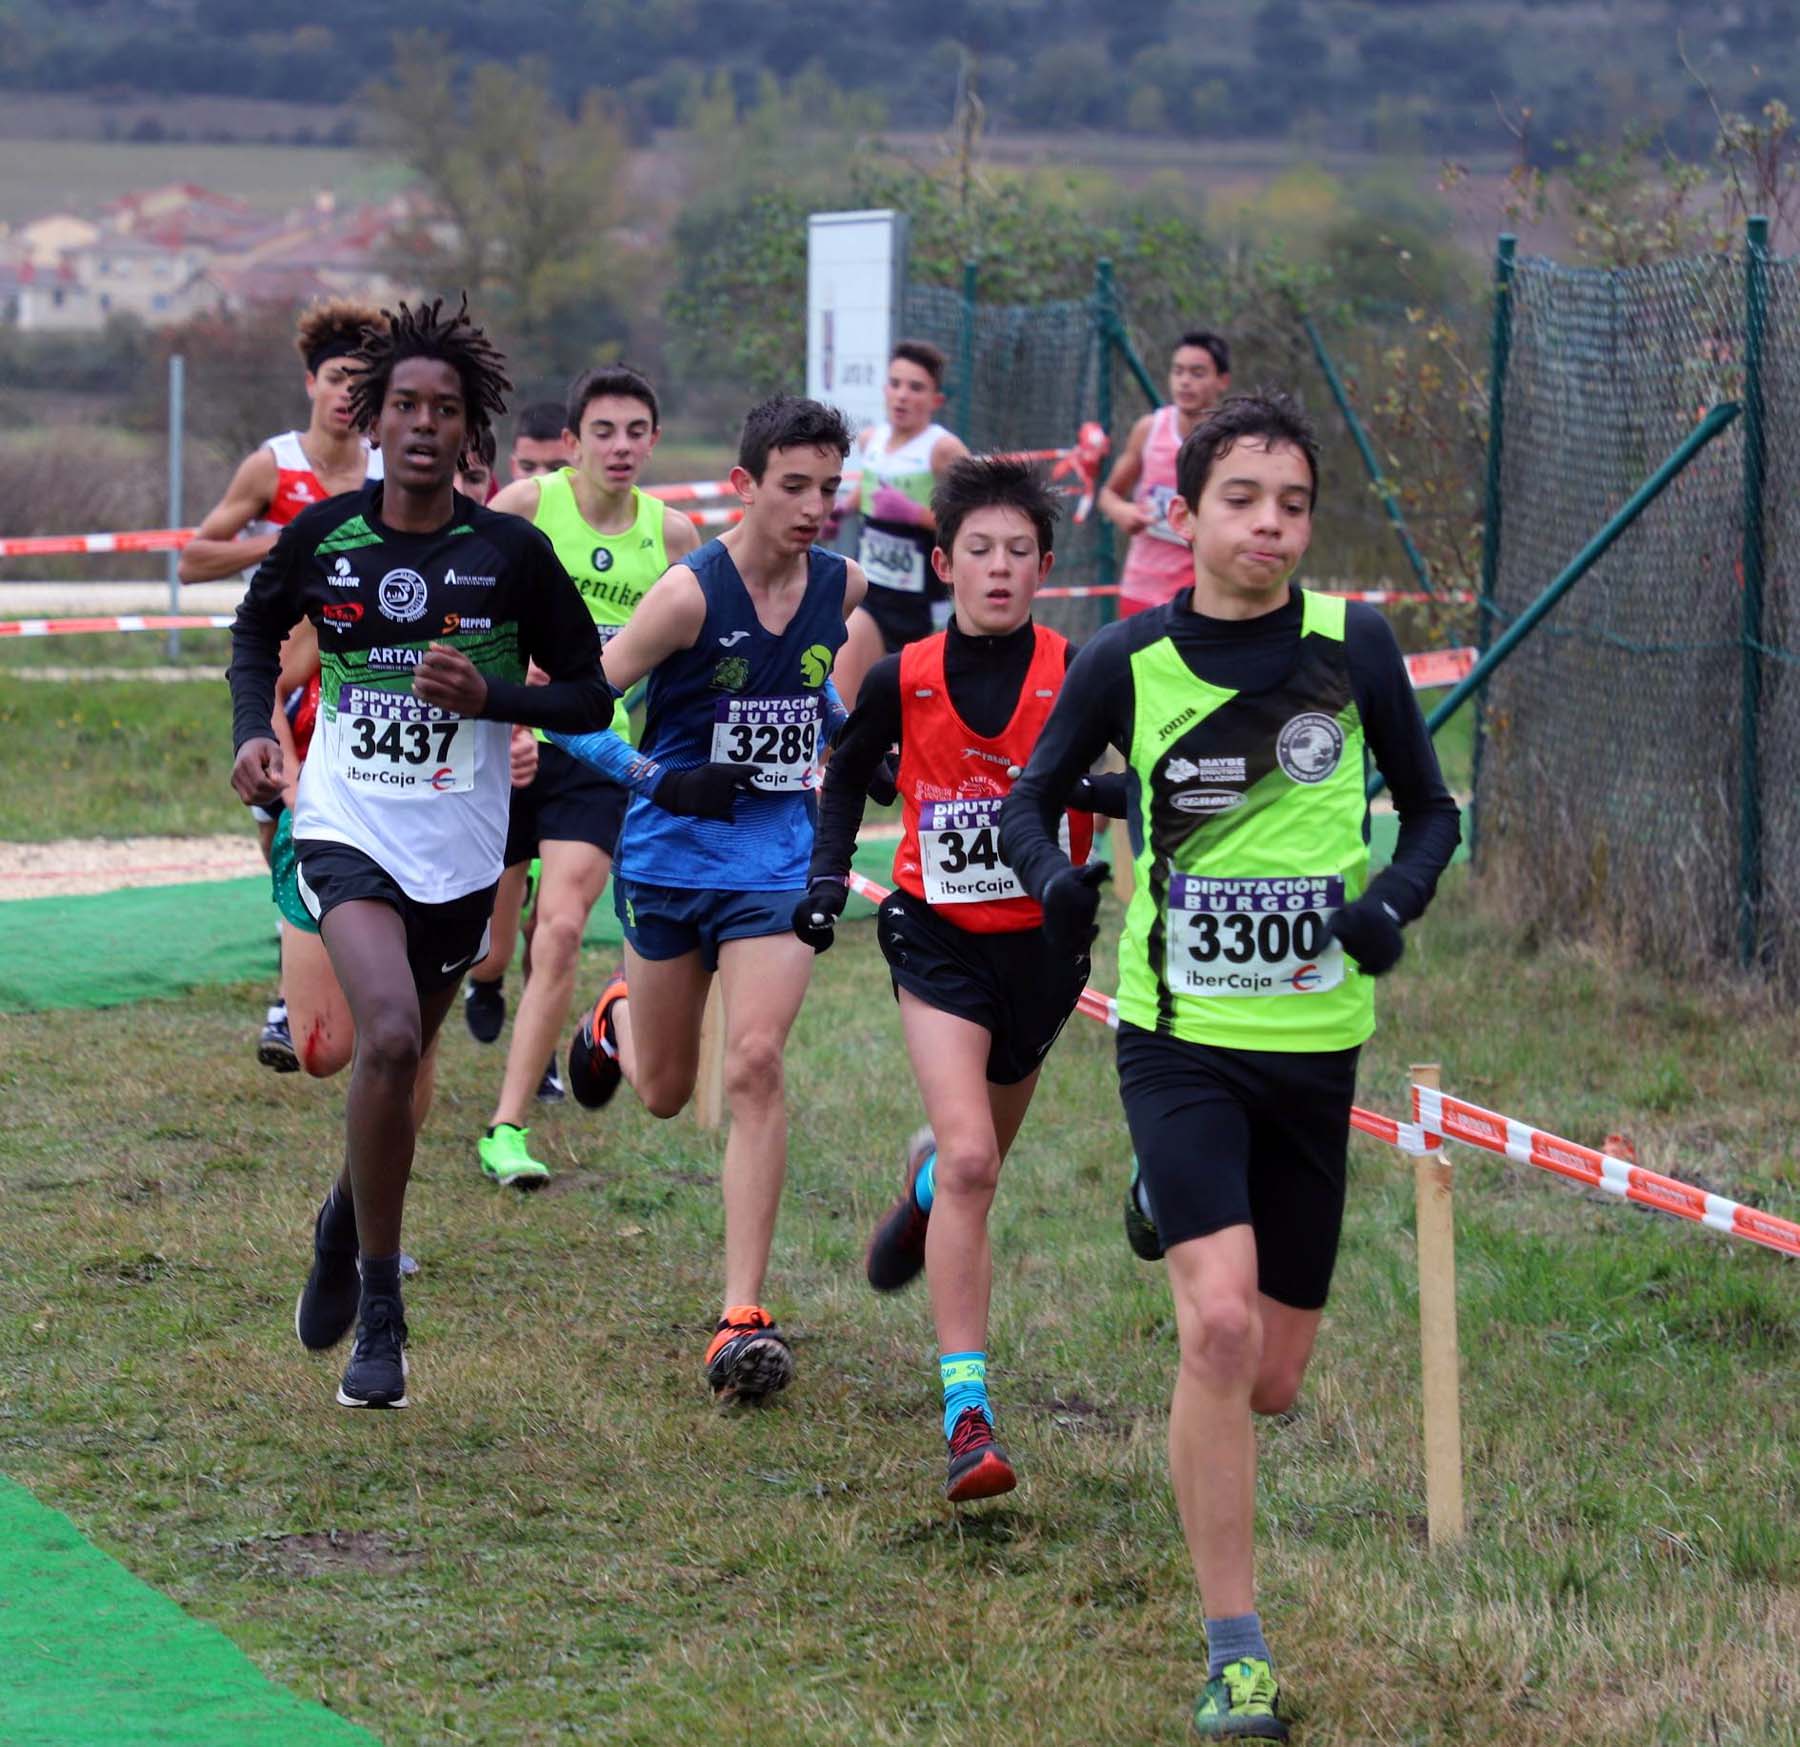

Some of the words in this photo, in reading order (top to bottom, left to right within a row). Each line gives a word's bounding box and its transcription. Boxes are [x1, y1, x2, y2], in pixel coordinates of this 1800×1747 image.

[368, 647, 423, 665] ARTAI
[728, 709, 817, 724] BURGOS
[351, 718, 459, 765] 3437
[728, 723, 815, 764] 3289
[347, 766, 415, 788] iberCaja
[941, 878, 1014, 895] iberCaja
[1185, 877, 1328, 896] DIPUTACIÓN
[1184, 893, 1327, 911] BURGOS
[1188, 911, 1324, 964] 3300
[1186, 970, 1272, 991] iberCaja
